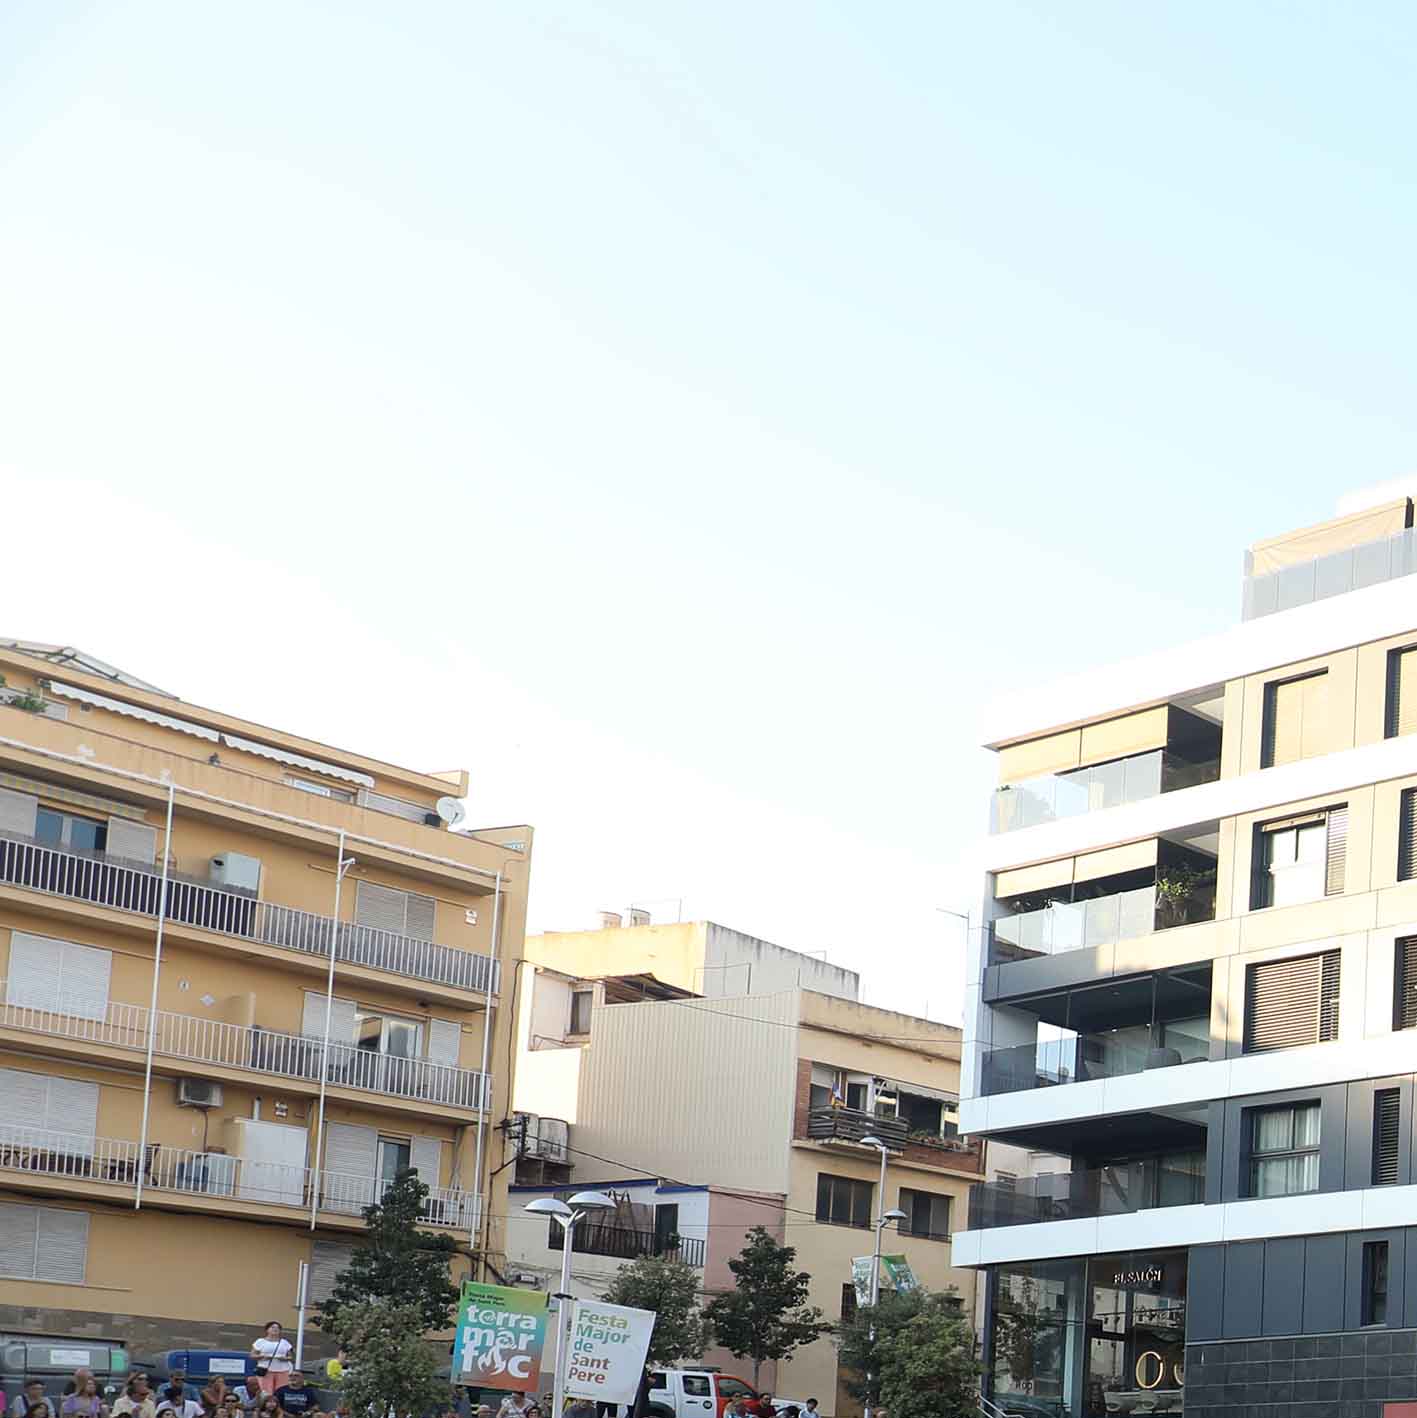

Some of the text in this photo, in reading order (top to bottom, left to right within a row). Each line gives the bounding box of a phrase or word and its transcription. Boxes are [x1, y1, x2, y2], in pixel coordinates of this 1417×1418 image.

[467, 1304, 537, 1330] terra
[578, 1309, 628, 1329] Festa
[463, 1326, 535, 1351] mar
[576, 1323, 631, 1345] Major
[574, 1338, 593, 1353] de
[570, 1352, 610, 1371] Sant
[568, 1367, 606, 1385] Pere
